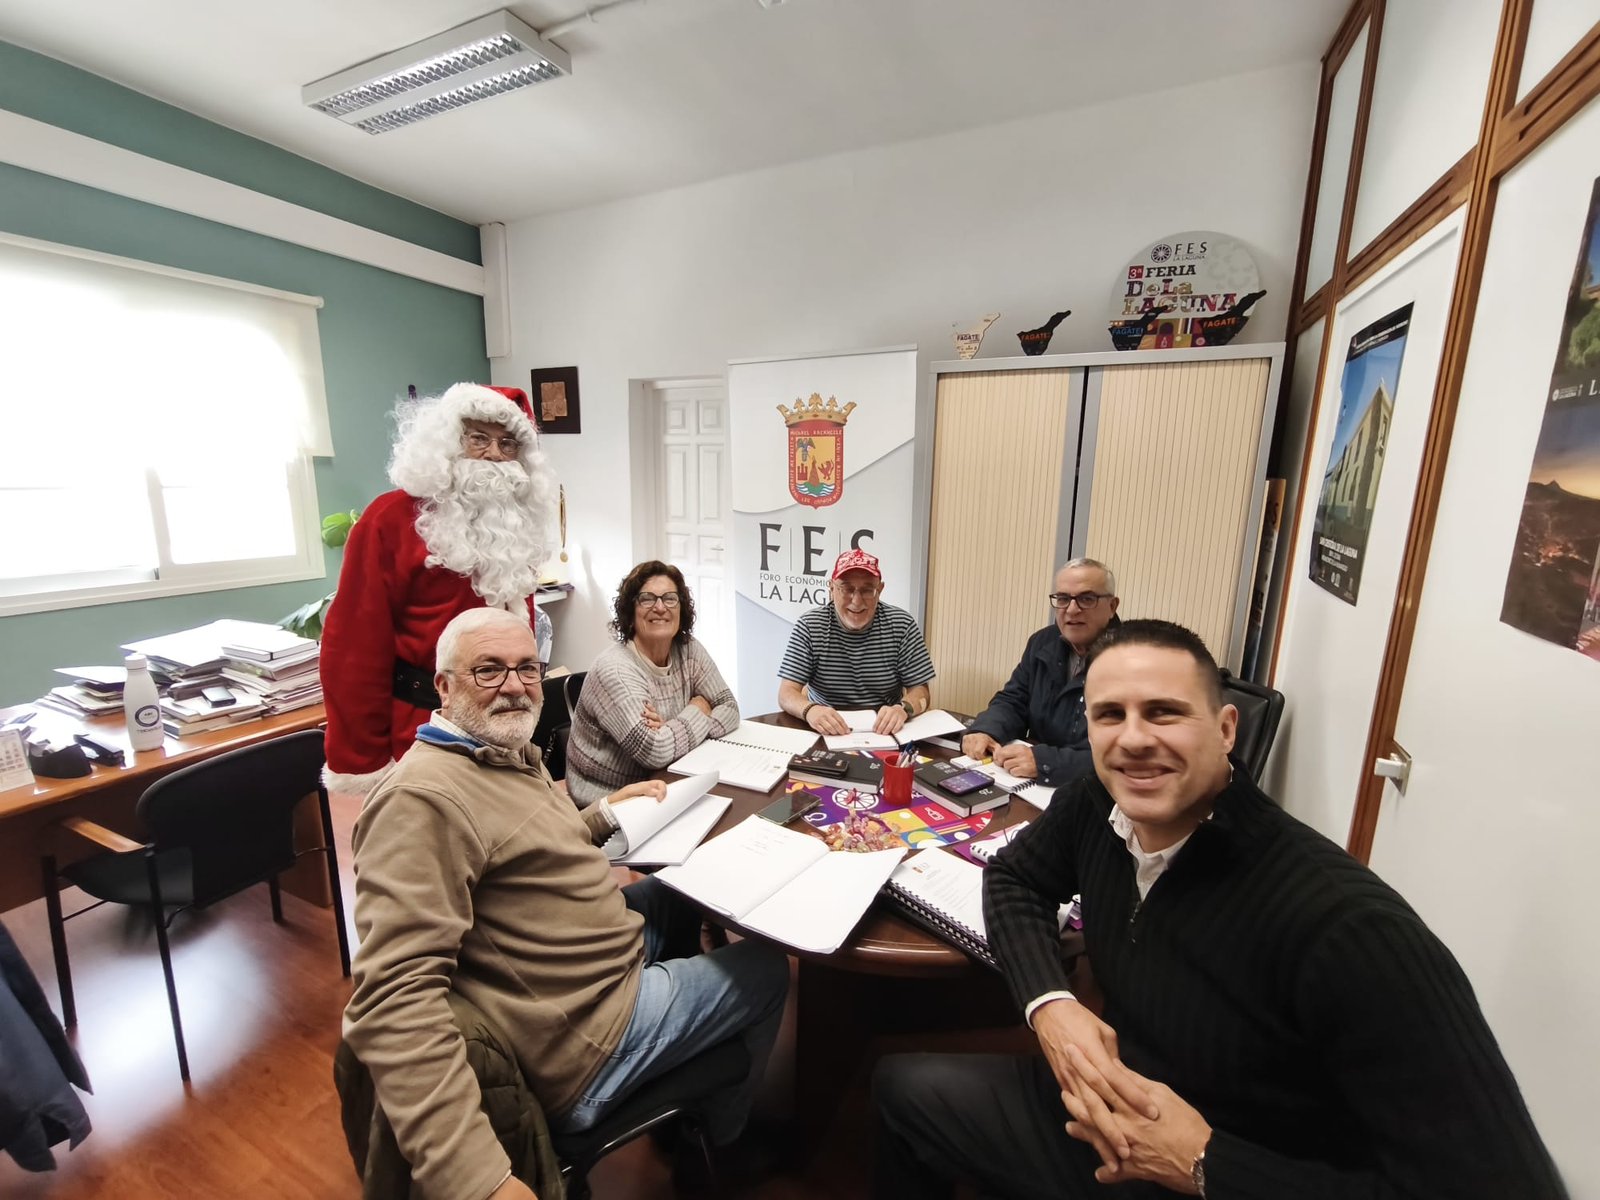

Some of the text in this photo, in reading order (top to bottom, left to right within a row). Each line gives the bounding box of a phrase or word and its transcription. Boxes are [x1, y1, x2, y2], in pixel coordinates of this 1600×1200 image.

[1174, 241, 1207, 255] FES
[1145, 265, 1196, 278] FERIA
[1122, 293, 1237, 316] LAGUNA
[760, 573, 781, 582] FORO
[760, 582, 832, 606] LA LAG
